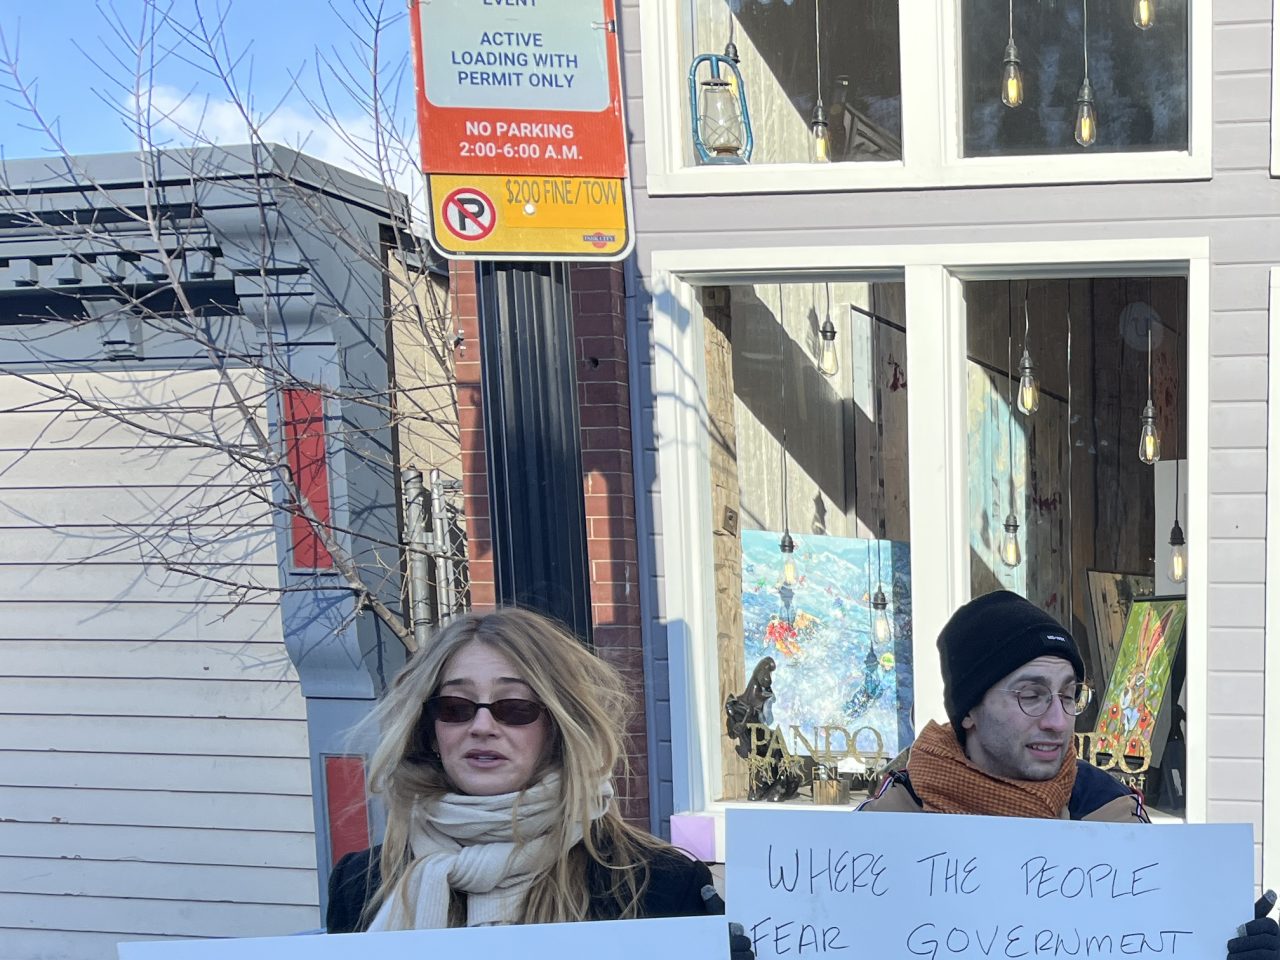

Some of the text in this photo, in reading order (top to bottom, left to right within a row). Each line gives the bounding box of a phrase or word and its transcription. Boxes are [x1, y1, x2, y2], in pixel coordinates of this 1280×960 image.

[480, 32, 543, 47] ACTIVE
[451, 51, 578, 68] LOADING WITH
[458, 71, 574, 88] PERMIT ONLY
[466, 121, 574, 139] NO PARKING
[459, 142, 583, 160] 2:00-6:00 A.M.
[506, 180, 540, 205] $200
[747, 722, 884, 768] PANDO
[768, 844, 1160, 898] WHERE THE PEOPLE
[750, 917, 850, 958] FEAR
